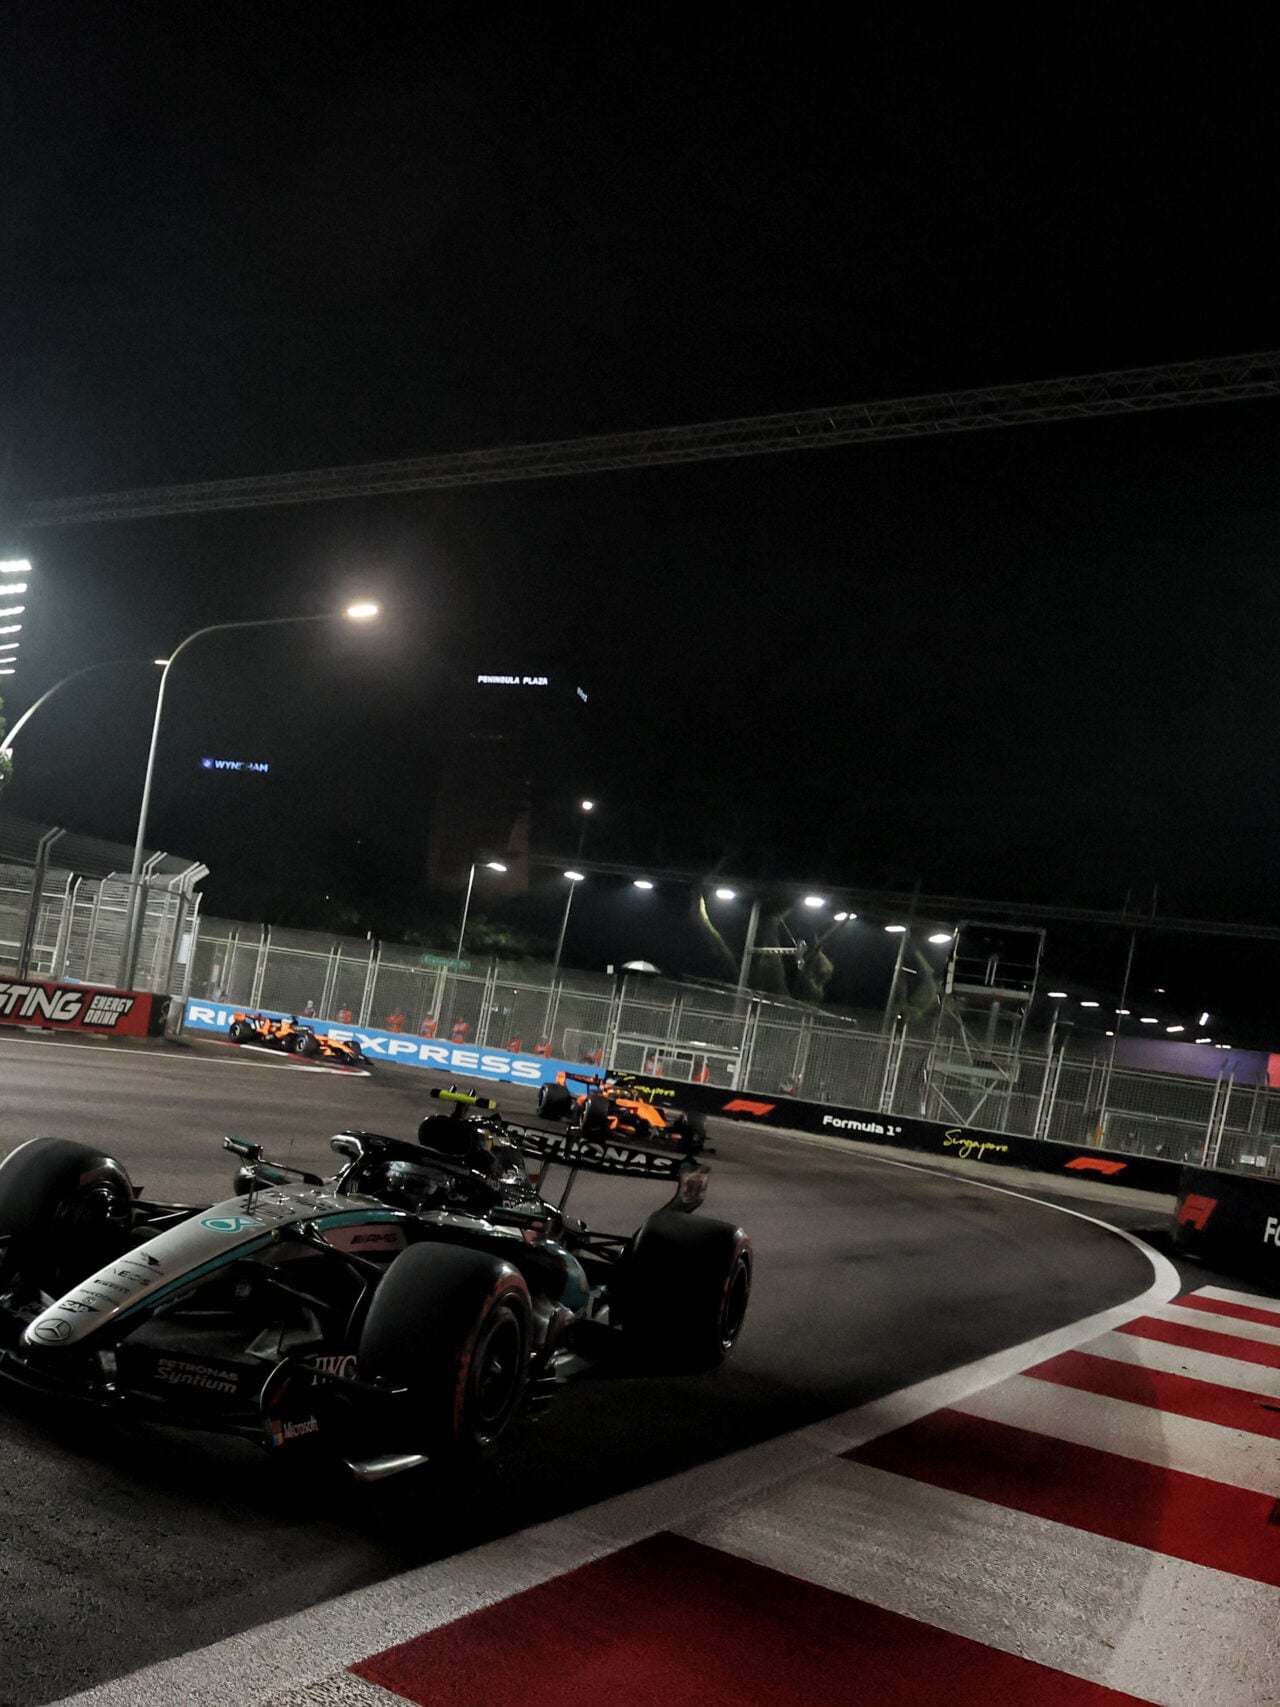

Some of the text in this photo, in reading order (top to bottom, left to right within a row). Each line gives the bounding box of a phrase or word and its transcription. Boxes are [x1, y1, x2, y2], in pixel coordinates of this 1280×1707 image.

[522, 677, 548, 686] PLAZA
[90, 995, 134, 1013] ENERGY
[83, 1009, 119, 1026] DRINK
[328, 1029, 542, 1079] EXPRESS
[822, 1115, 884, 1135] Formula
[943, 1128, 1009, 1160] Singapore
[154, 1366, 238, 1394] Syntium
[158, 1358, 239, 1381] PETRONAS
[283, 1414, 319, 1439] Microsoft
